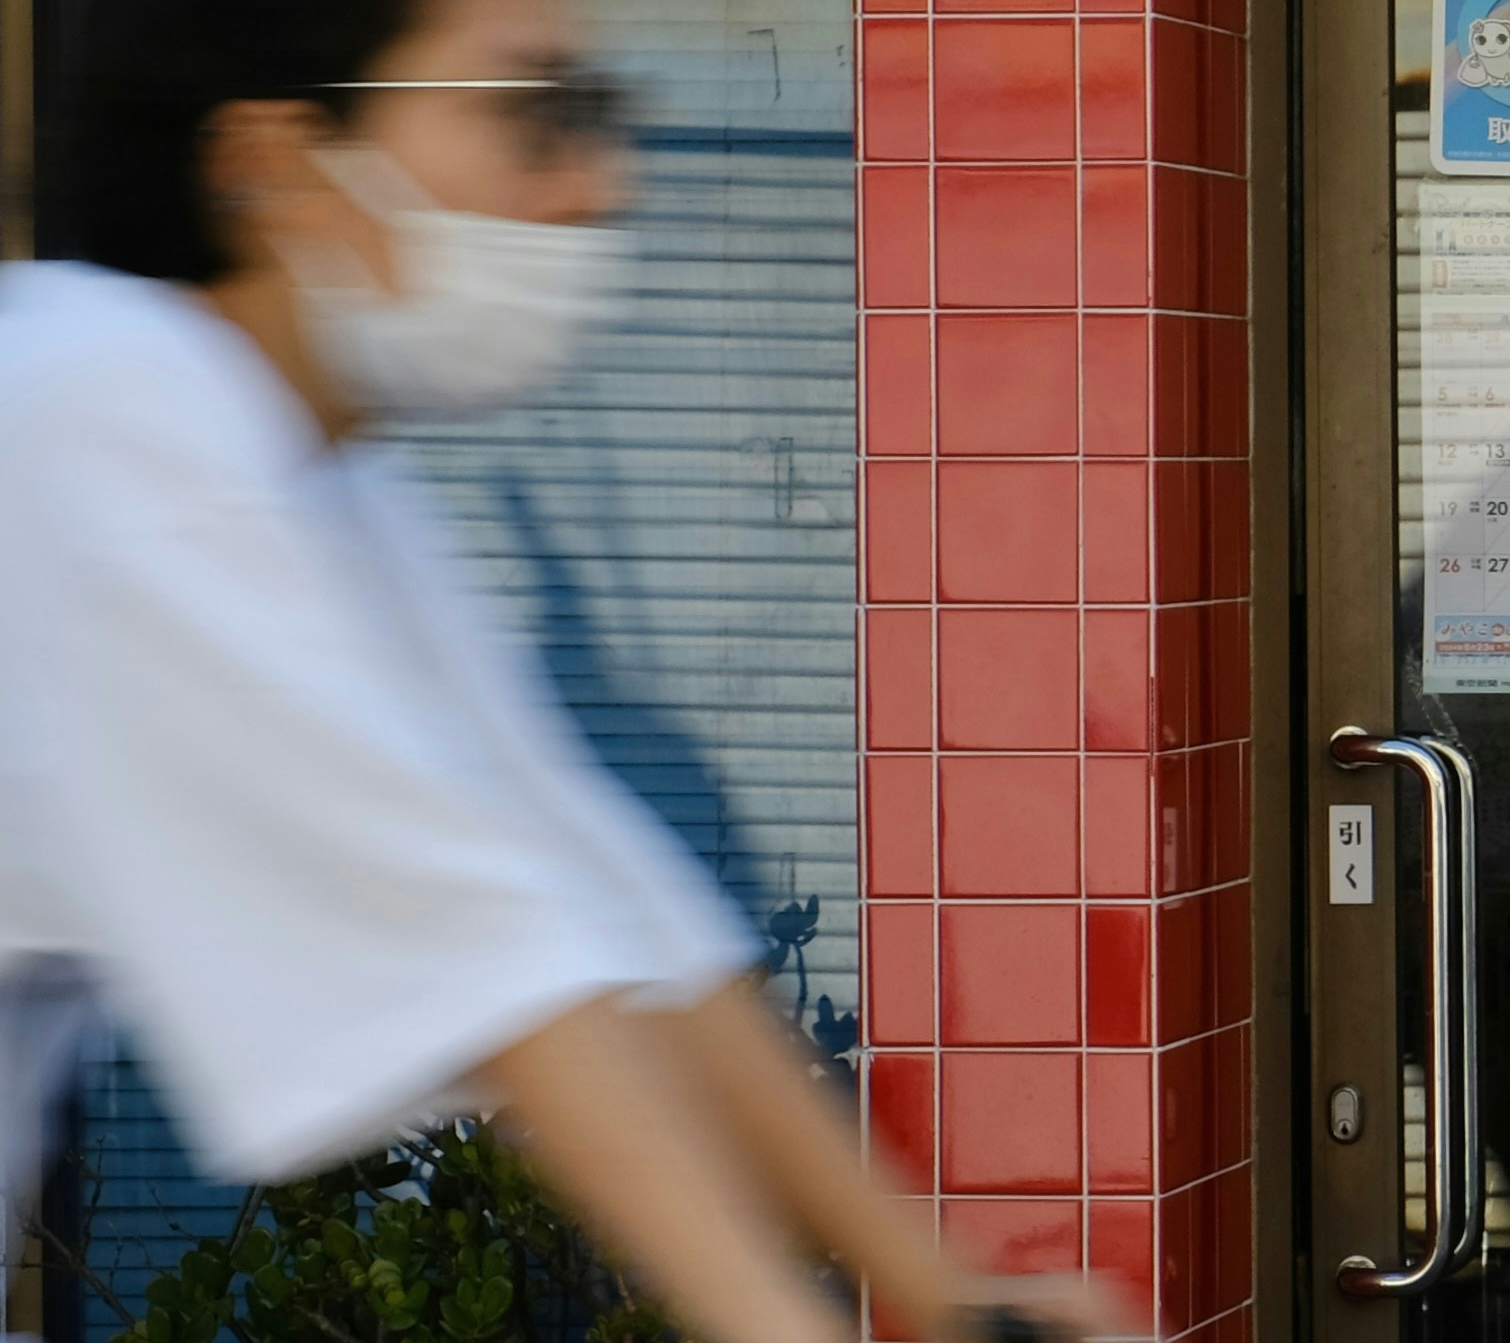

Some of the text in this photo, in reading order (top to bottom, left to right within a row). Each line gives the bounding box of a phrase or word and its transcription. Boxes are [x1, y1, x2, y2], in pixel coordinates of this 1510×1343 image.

[1488, 444, 1505, 458] 13
[1487, 502, 1508, 515] 20
[1440, 558, 1460, 572] 26
[1488, 558, 1508, 572] 27
[1338, 821, 1362, 890] 引く
